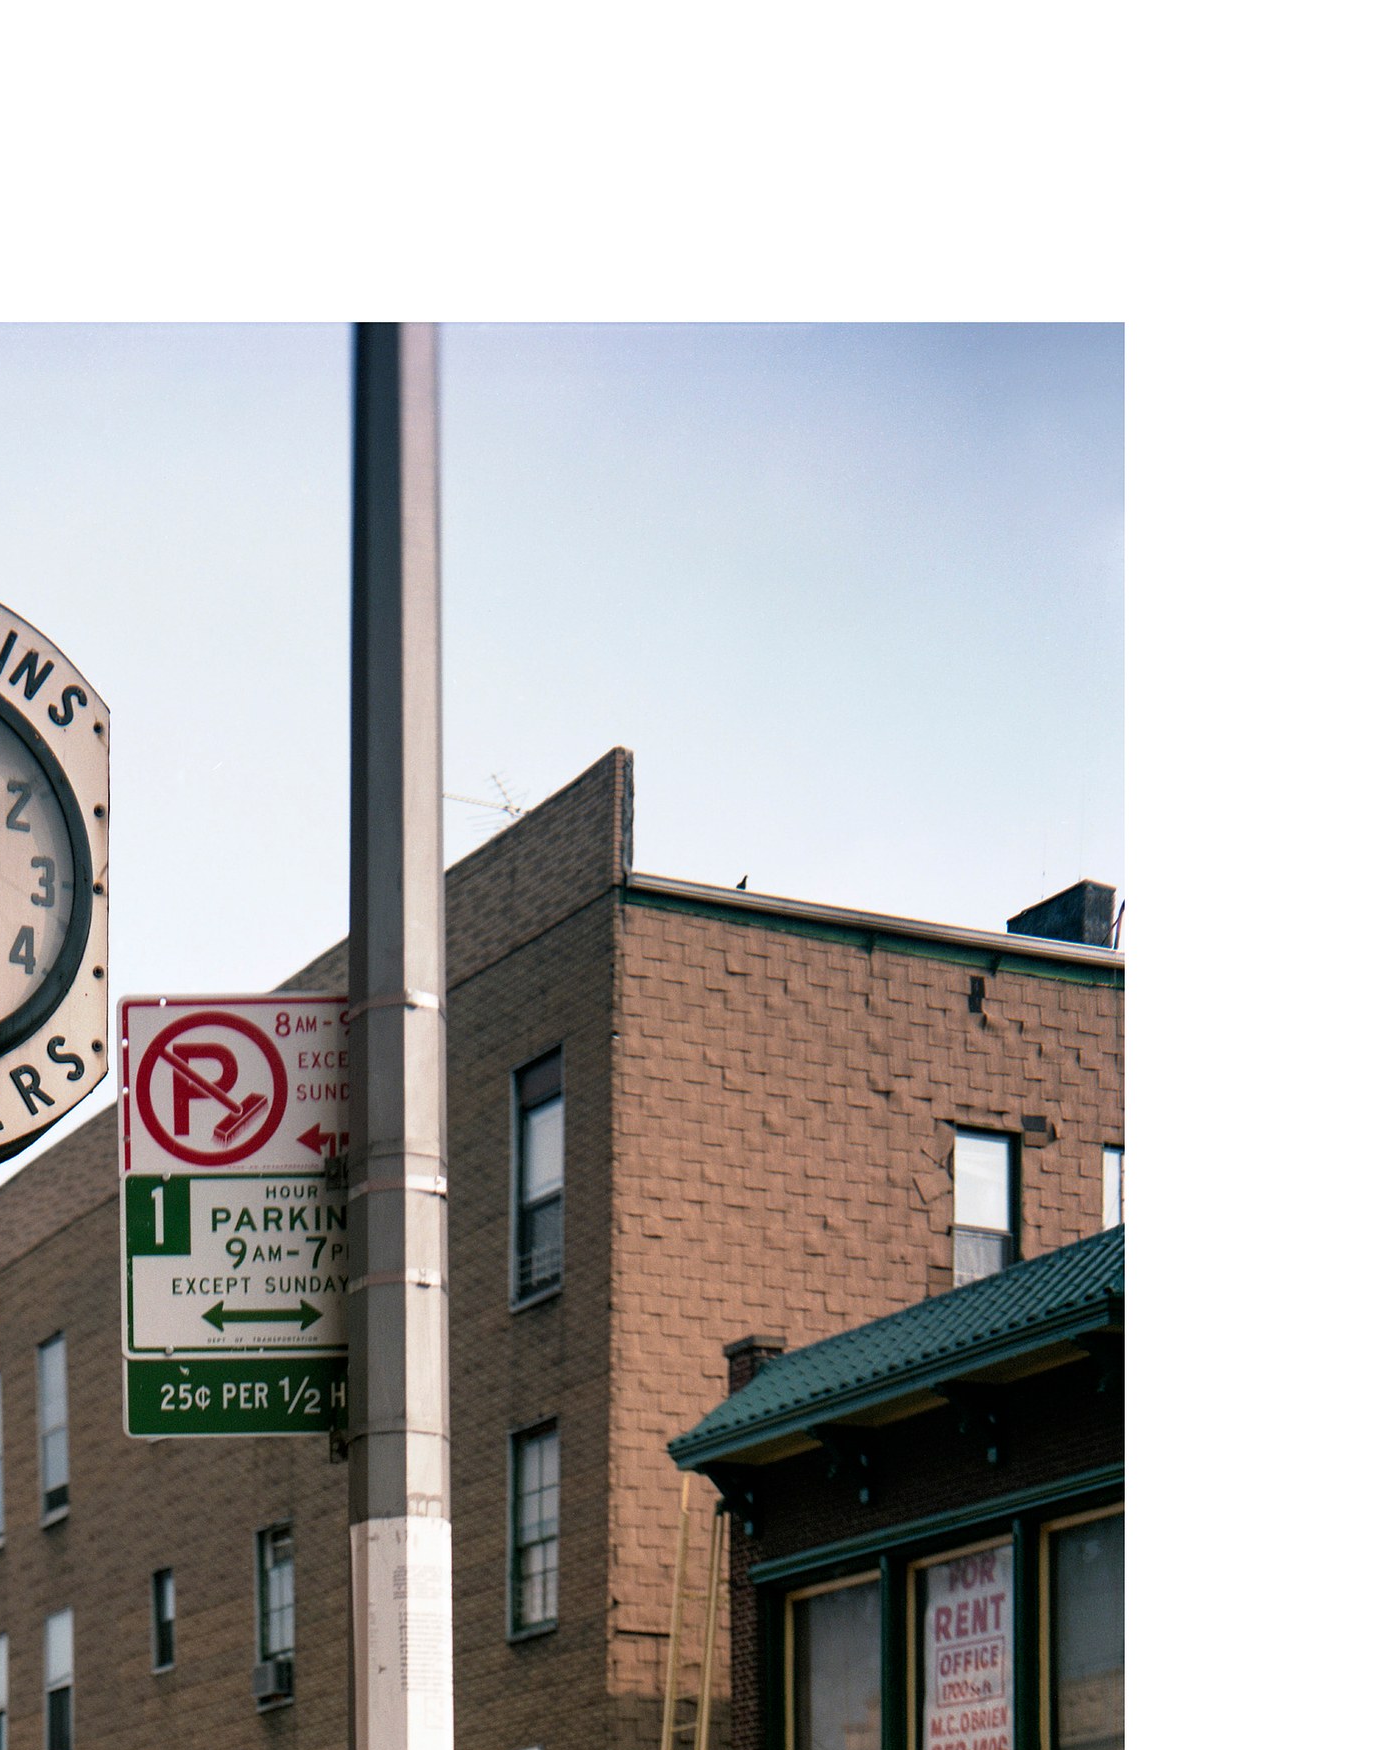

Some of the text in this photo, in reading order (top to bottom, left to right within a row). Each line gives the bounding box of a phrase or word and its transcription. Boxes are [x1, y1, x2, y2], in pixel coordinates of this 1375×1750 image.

[6, 780, 32, 832] 2
[30, 855, 56, 908] 3
[9, 925, 37, 975] 4
[298, 1050, 349, 1069] EXCE
[296, 1083, 351, 1101] SUND
[266, 1185, 318, 1199] HOUR
[150, 1186, 165, 1246] 1
[211, 1205, 347, 1232] PARKIN
[225, 1236, 350, 1270] 9AM-7P
[172, 1275, 349, 1295] EXCEPT SUNDAY
[160, 1383, 211, 1411] 25¢
[222, 1382, 269, 1410] PER
[331, 1381, 346, 1408] H
[935, 1593, 1006, 1643] RENT
[940, 1645, 999, 1677] OFFICE
